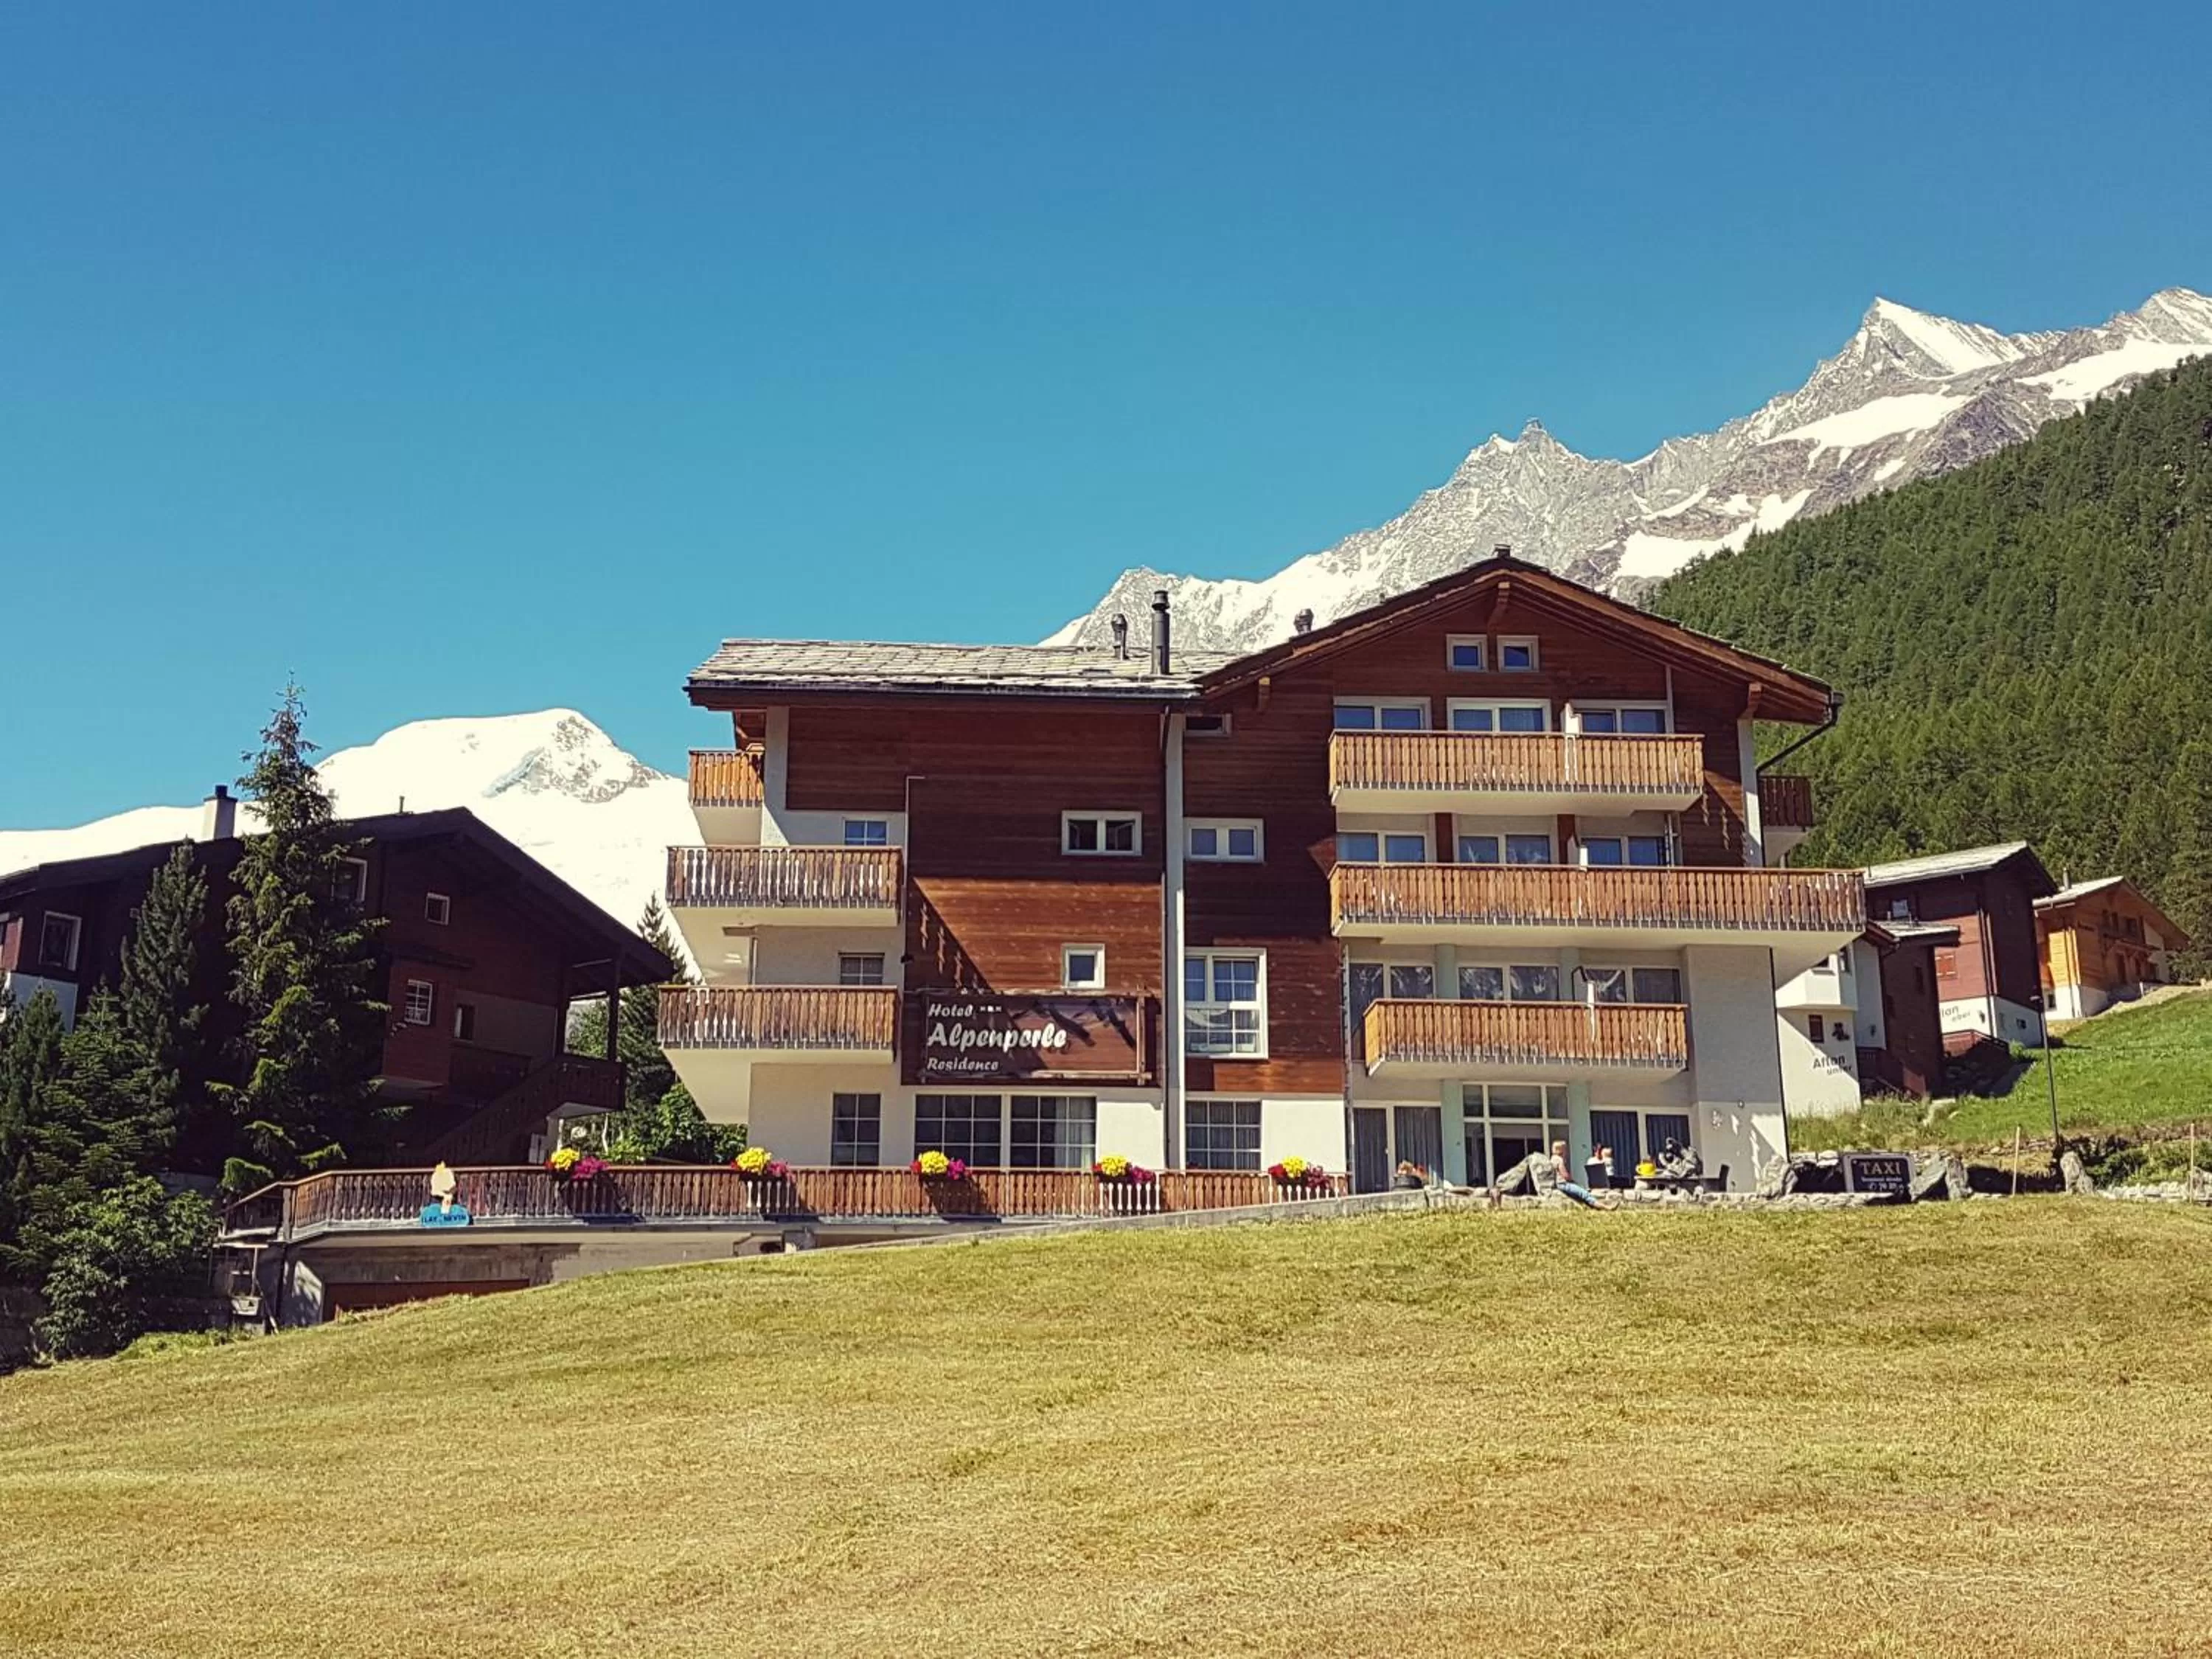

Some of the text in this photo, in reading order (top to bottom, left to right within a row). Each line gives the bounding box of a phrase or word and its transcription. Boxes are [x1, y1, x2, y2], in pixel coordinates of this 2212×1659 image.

[928, 1004, 973, 1017] Hotel
[927, 1023, 1067, 1052] Alpenperle
[927, 1057, 999, 1071] Residence
[1859, 1161, 1901, 1175] TAXI
